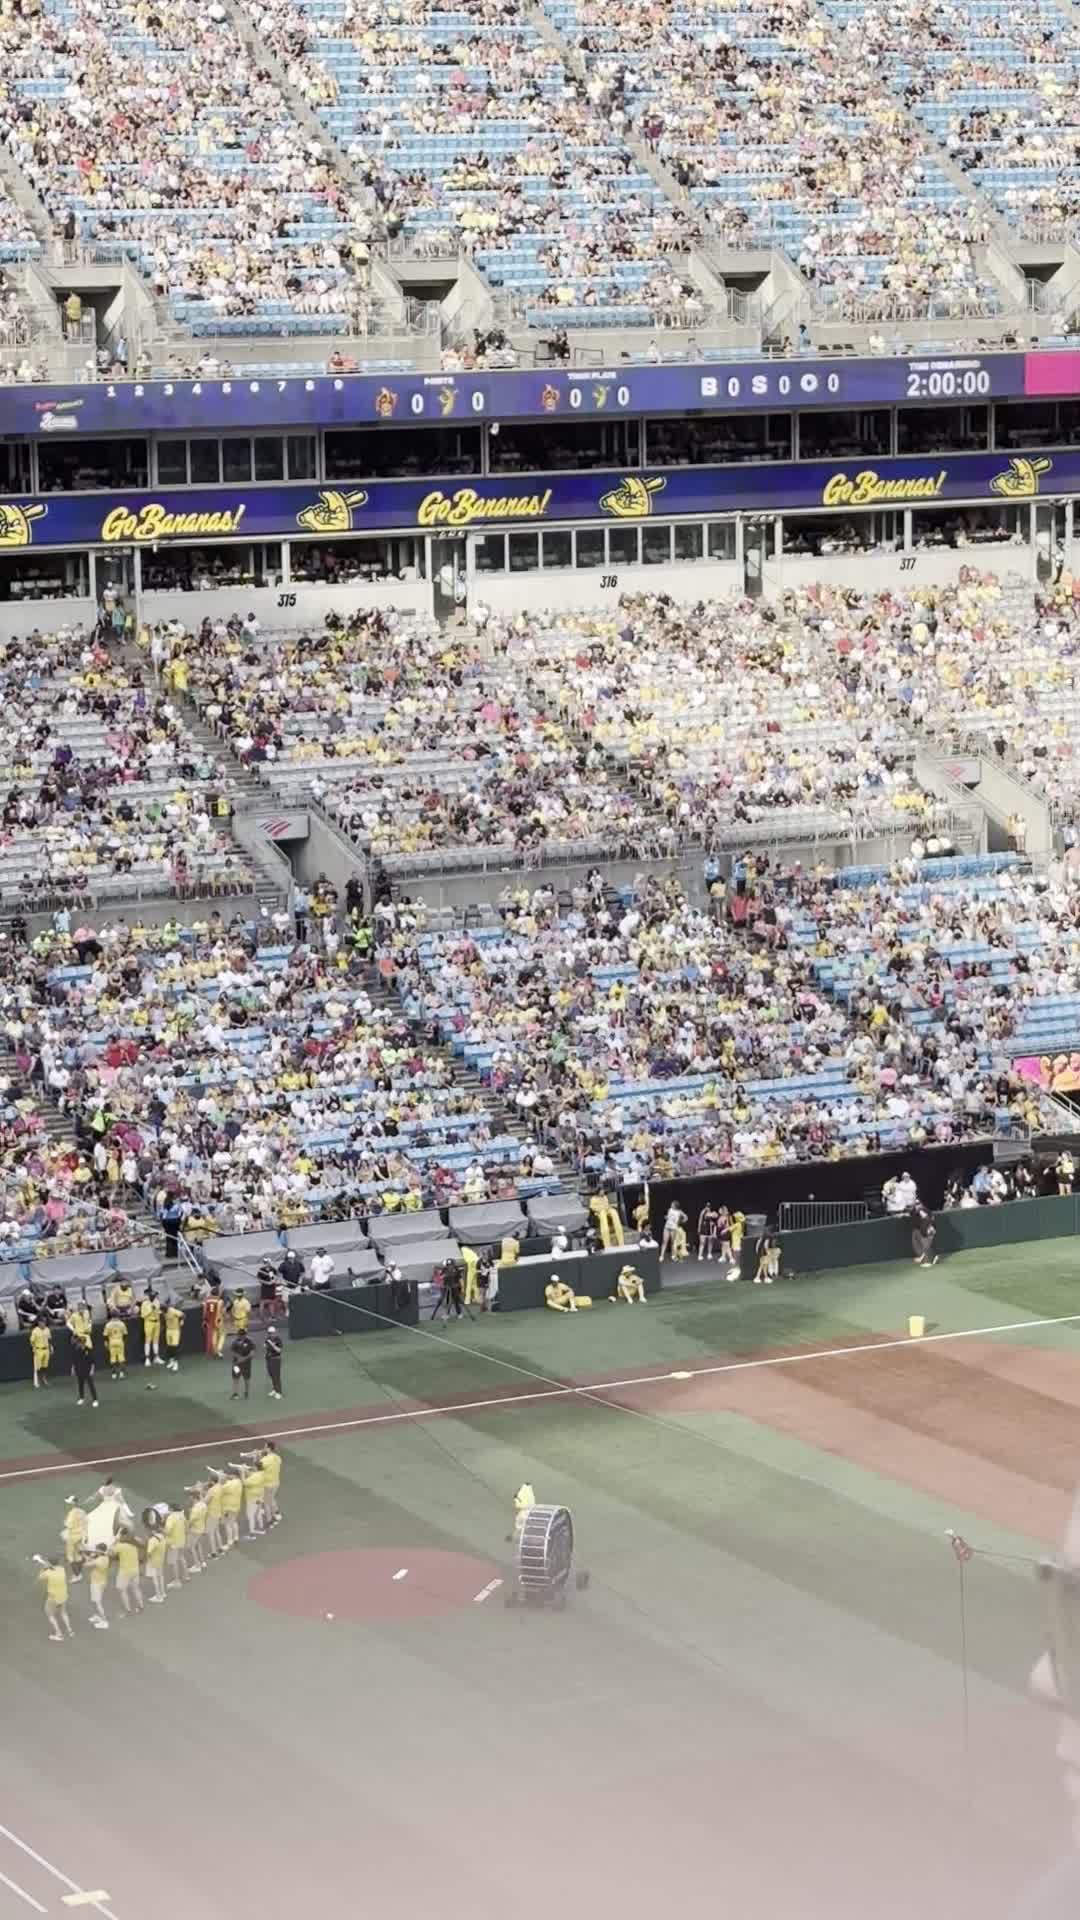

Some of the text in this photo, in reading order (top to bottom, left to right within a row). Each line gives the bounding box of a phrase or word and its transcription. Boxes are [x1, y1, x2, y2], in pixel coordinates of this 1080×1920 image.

[106, 385, 116, 398] 1
[134, 384, 144, 397] 2
[163, 383, 174, 396] 3
[191, 383, 202, 395] 4
[277, 380, 287, 392] 7
[701, 372, 840, 397] B 0 S 0 O 0
[907, 371, 990, 397] 2:00:00
[411, 391, 484, 414] 0 0
[569, 386, 630, 409] 0 0
[824, 469, 947, 506] Go Bananas!
[417, 488, 552, 526] Go Bananas!
[101, 503, 246, 541] Go Bananas!
[900, 557, 916, 571] 317
[600, 575, 618, 589] 316
[277, 593, 297, 608] 315
